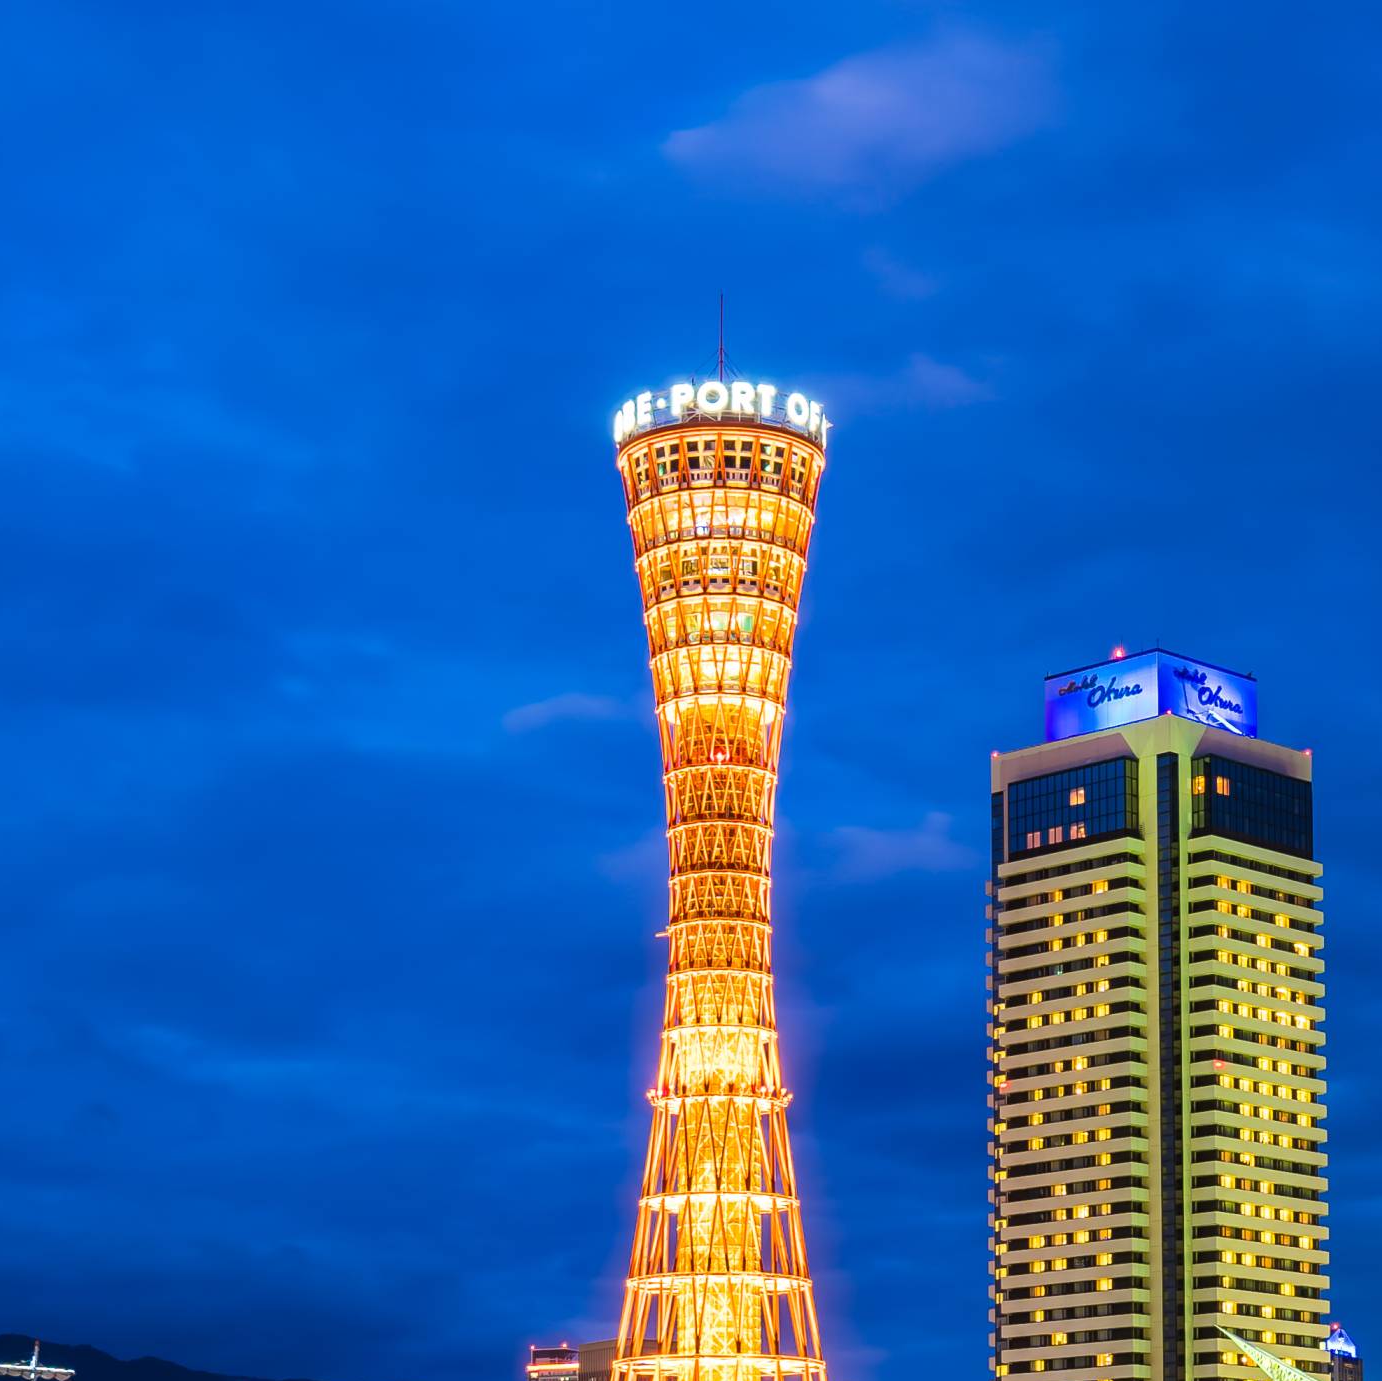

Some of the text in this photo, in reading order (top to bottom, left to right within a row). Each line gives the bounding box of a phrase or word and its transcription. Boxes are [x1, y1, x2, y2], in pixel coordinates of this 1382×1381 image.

[670, 381, 776, 417] PORT
[1087, 676, 1143, 708] Okura
[1198, 685, 1244, 714] Okura
